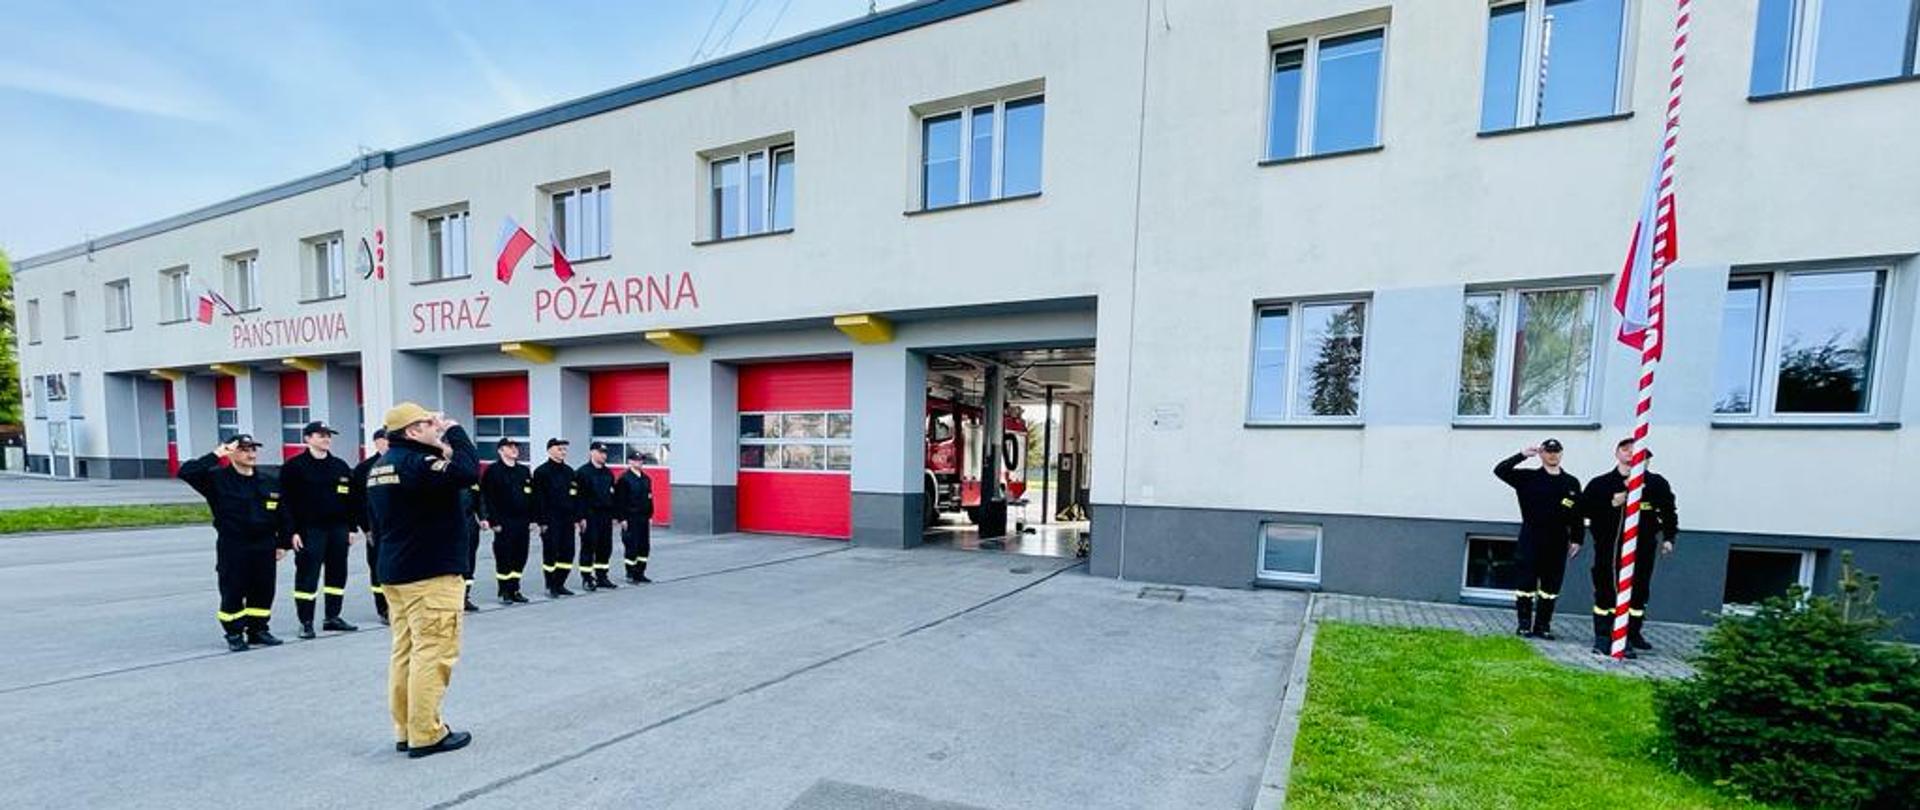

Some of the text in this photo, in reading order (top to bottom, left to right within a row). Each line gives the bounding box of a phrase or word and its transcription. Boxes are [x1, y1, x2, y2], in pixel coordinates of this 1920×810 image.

[412, 271, 700, 334] STRAŻ POŻARNA
[232, 312, 348, 348] PAŃSTWOWA
